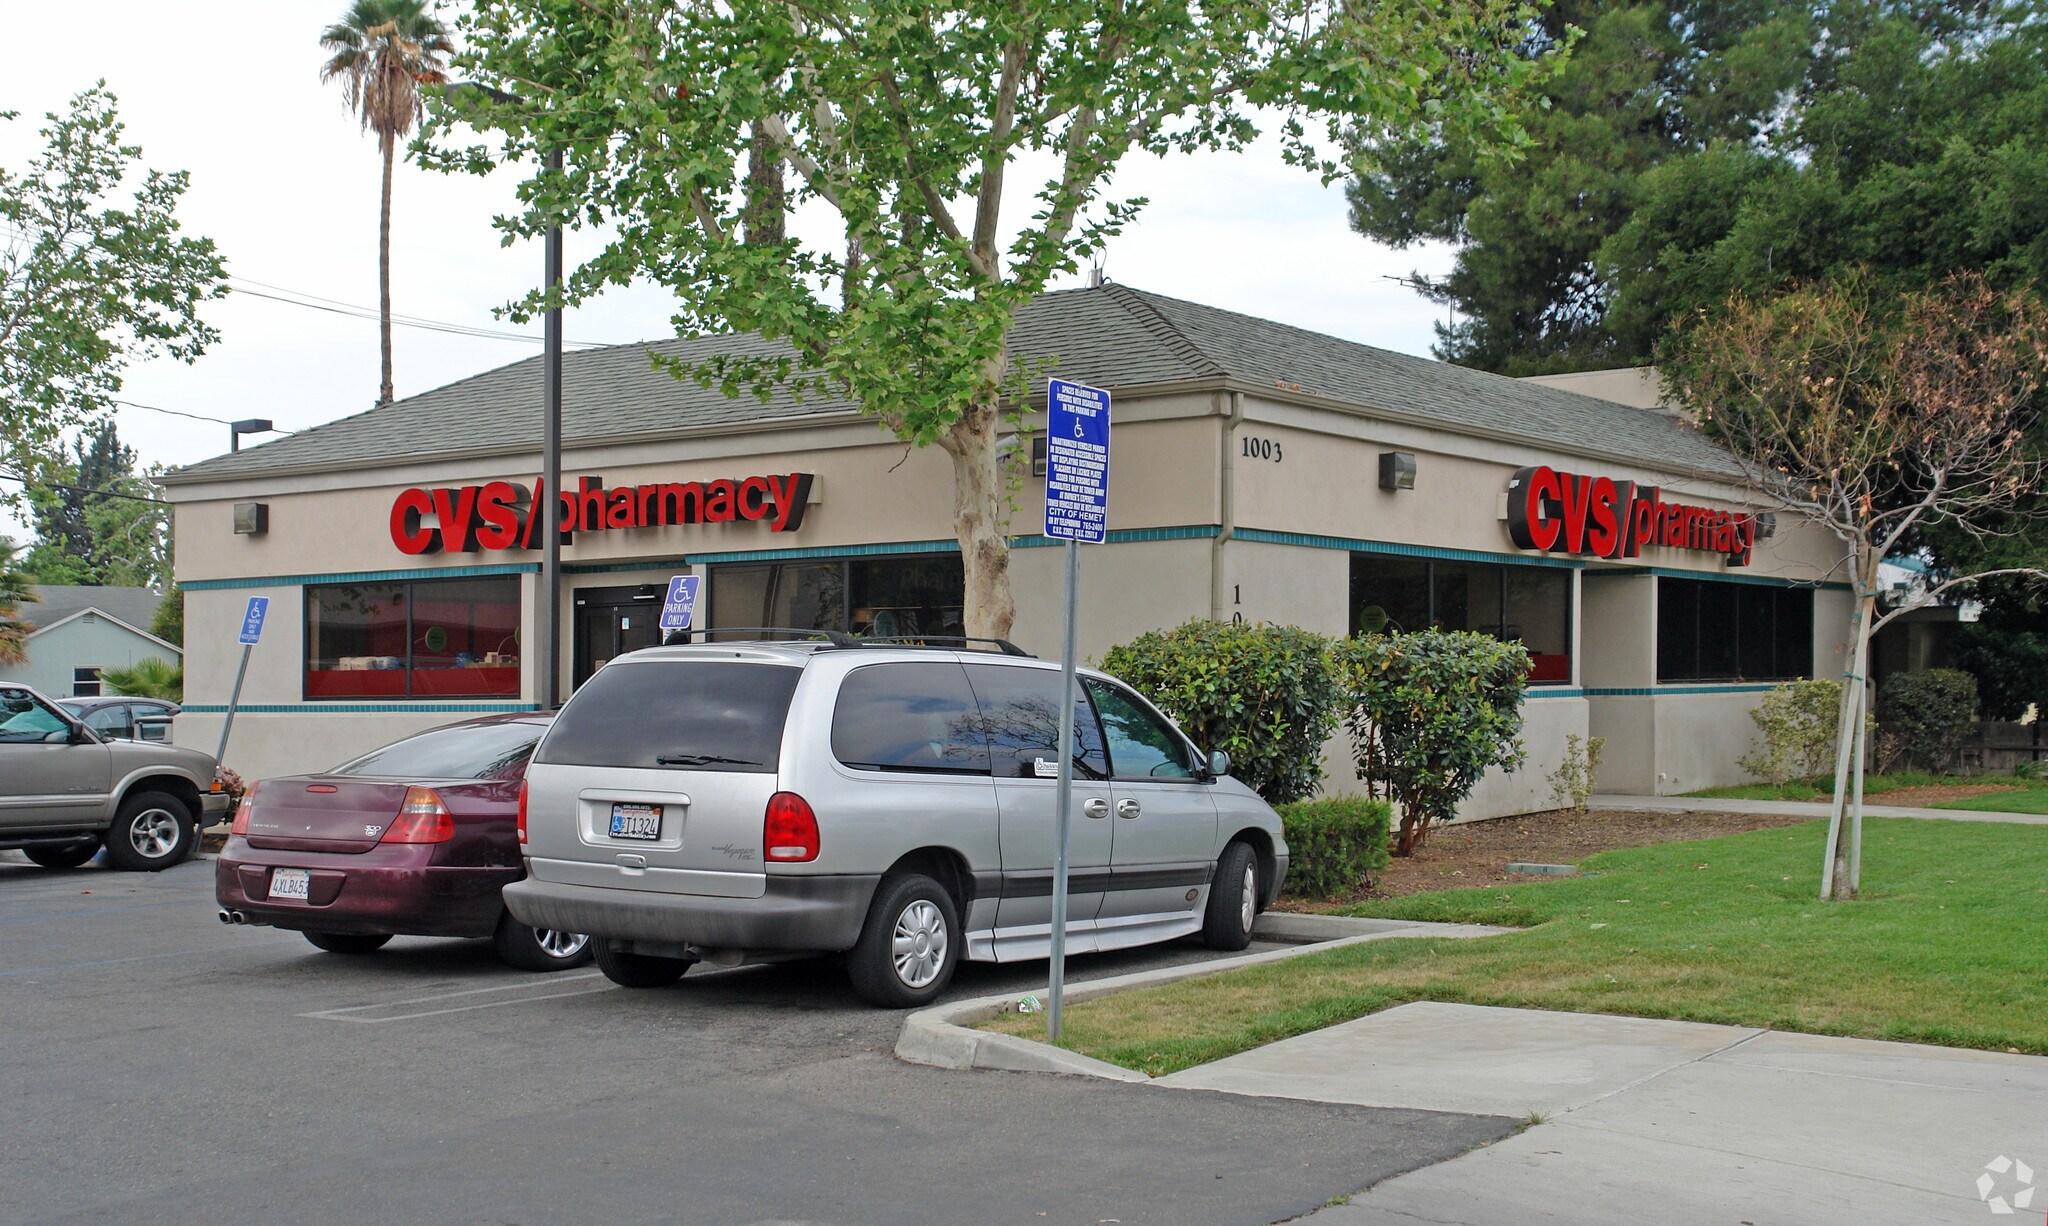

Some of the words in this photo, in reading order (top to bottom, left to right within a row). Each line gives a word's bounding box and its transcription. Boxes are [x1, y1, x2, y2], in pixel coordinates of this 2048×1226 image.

[1242, 437, 1282, 463] 1003
[1049, 506, 1065, 516] CITY
[1068, 509, 1077, 518] OF
[1079, 511, 1102, 522] HEMET
[1527, 466, 1757, 567] CVS/pharmacy
[665, 603, 693, 613] PARKING
[667, 615, 685, 625] ONLY
[273, 879, 309, 895] 4XLB453
